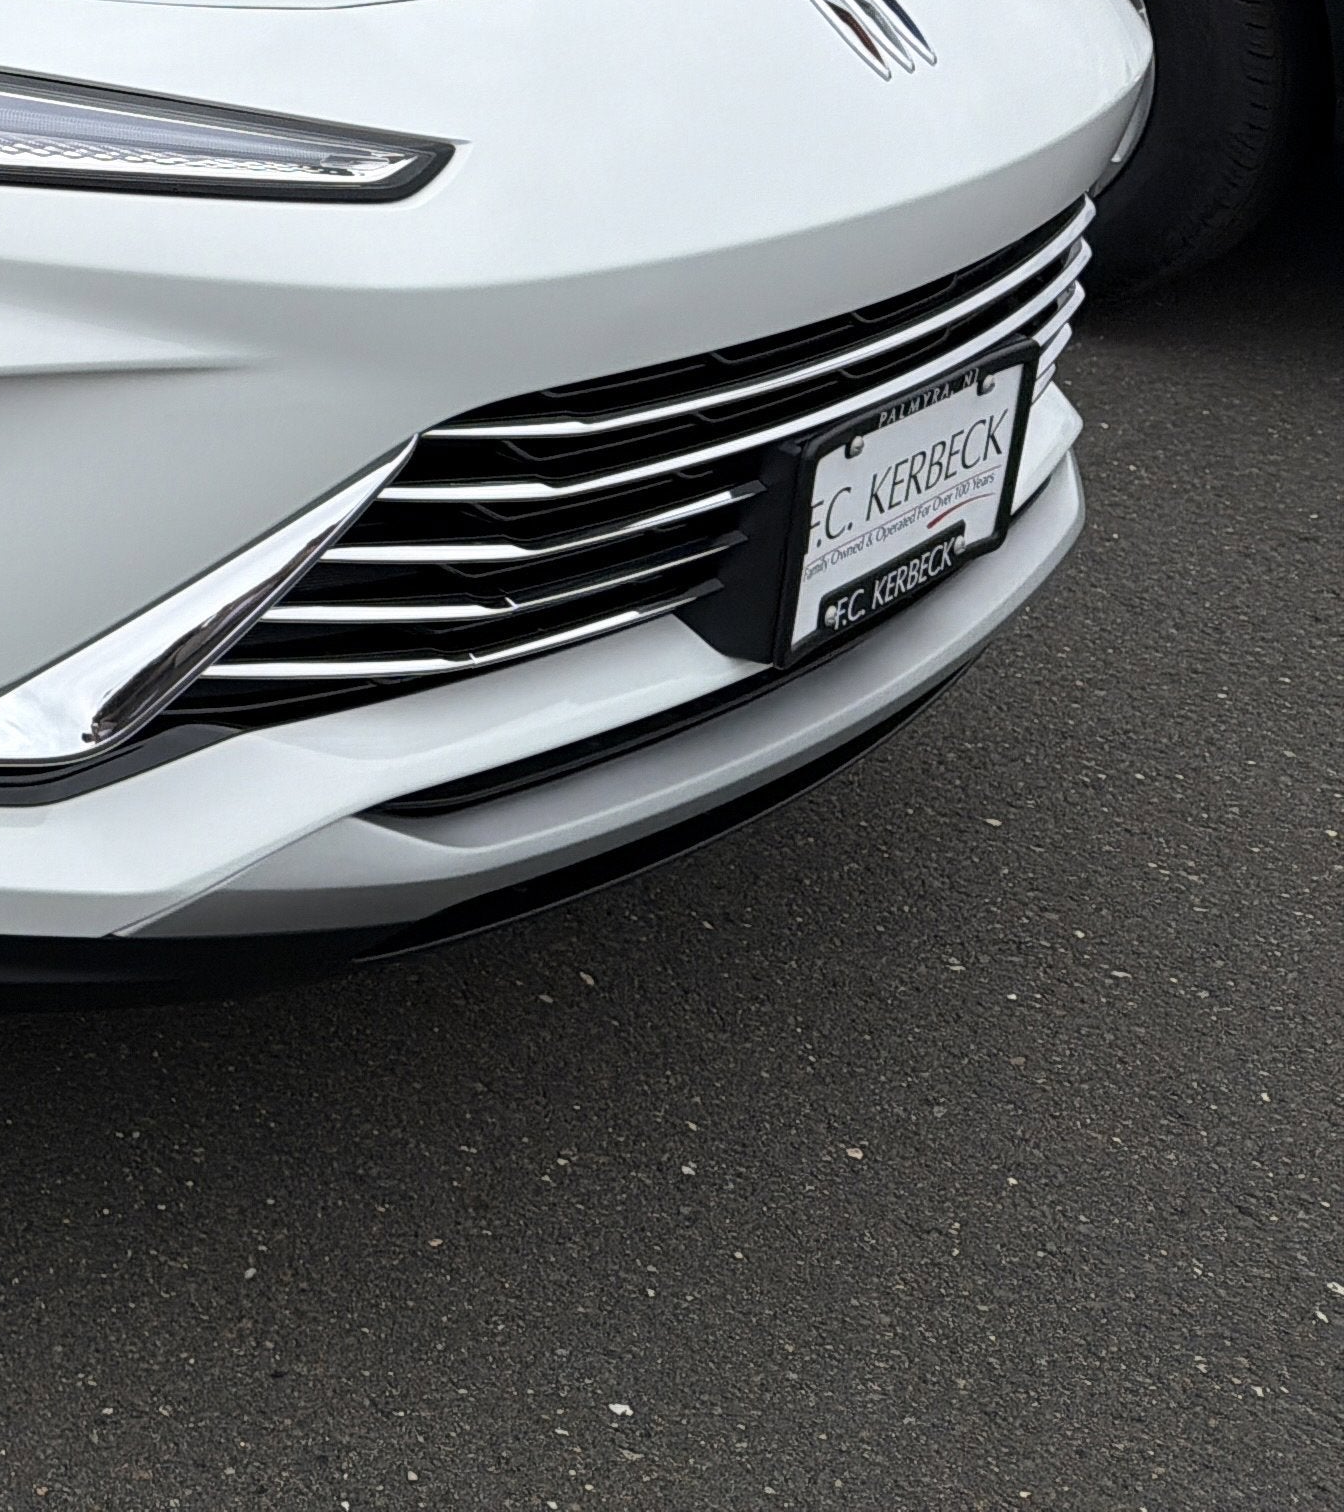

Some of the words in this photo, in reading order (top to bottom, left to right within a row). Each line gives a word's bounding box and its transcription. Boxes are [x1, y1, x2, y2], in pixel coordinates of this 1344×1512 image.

[865, 408, 1009, 522] KERBECK
[831, 535, 866, 565] Owned
[865, 531, 874, 548] &
[876, 506, 917, 542] Operated
[917, 504, 932, 521] For
[933, 493, 953, 512] Over
[954, 480, 971, 500] 100
[973, 472, 996, 491] Years
[834, 588, 866, 630] F.C.
[871, 537, 956, 610] KERBECK
